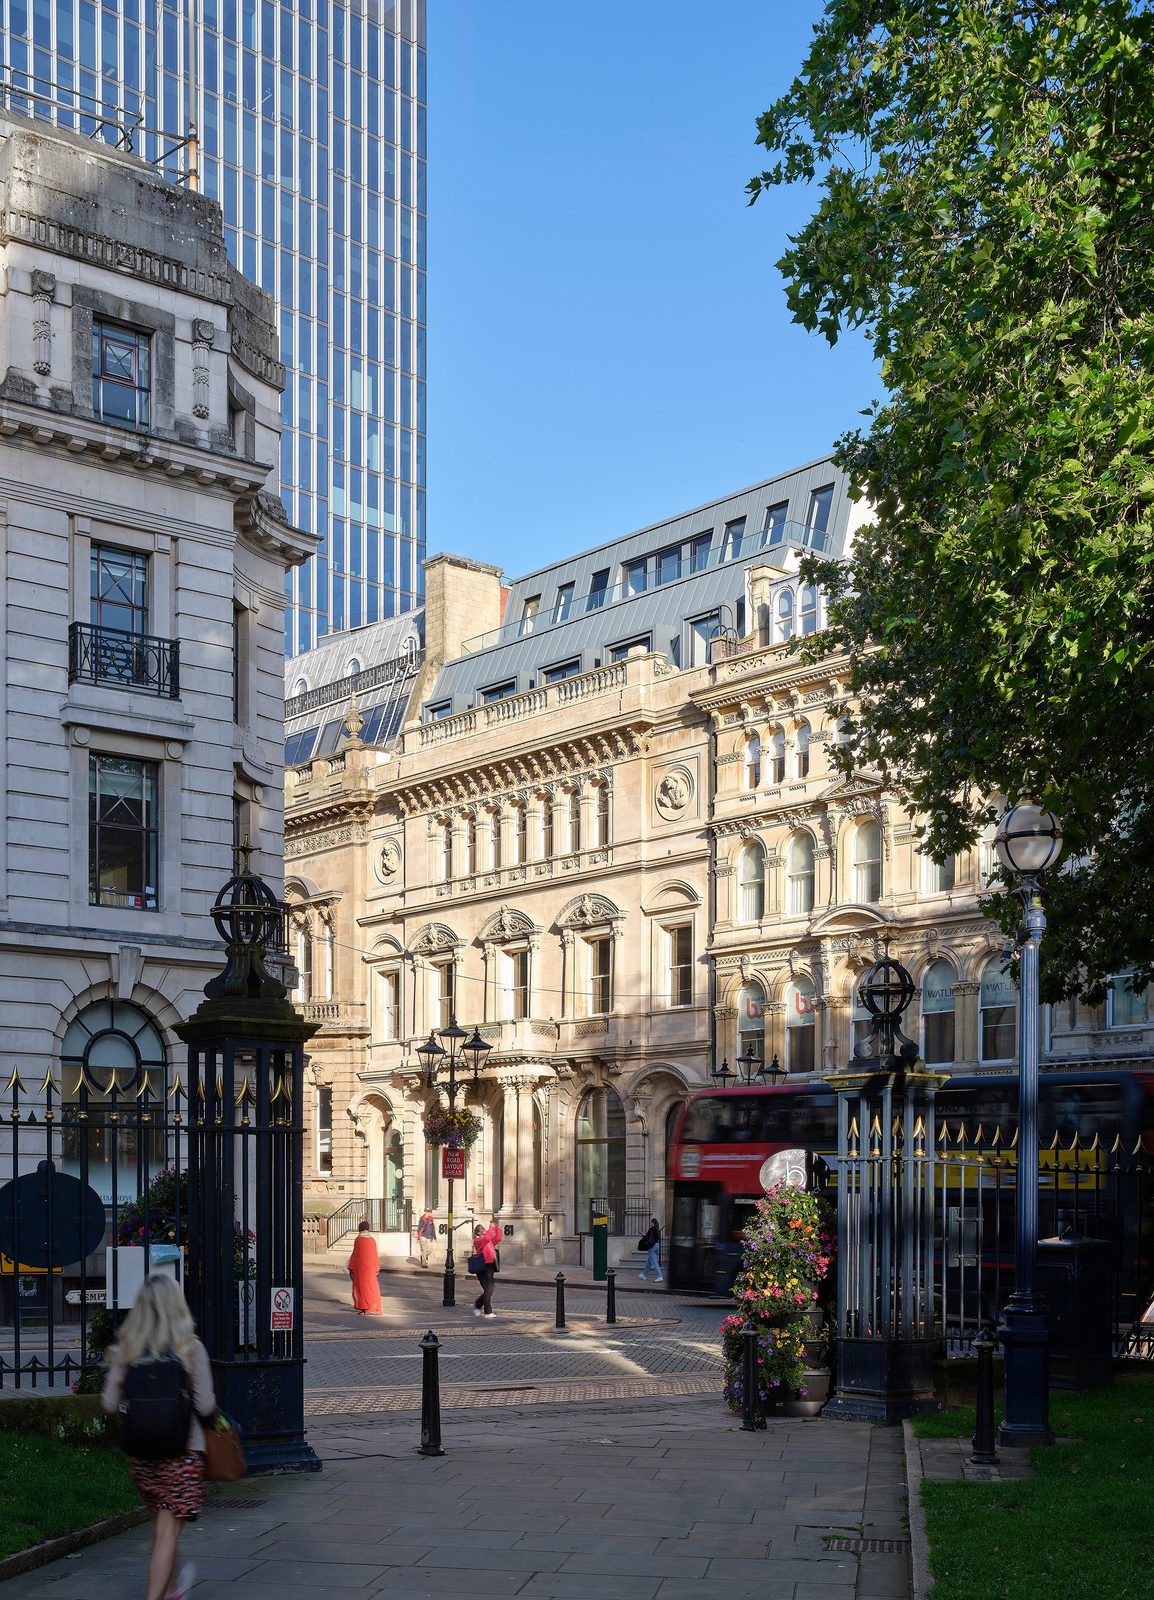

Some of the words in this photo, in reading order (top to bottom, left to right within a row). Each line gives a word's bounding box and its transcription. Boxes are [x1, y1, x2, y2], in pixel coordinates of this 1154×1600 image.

[928, 988, 955, 998] WATLI
[438, 1223, 448, 1235] 81
[504, 1224, 514, 1236] 81
